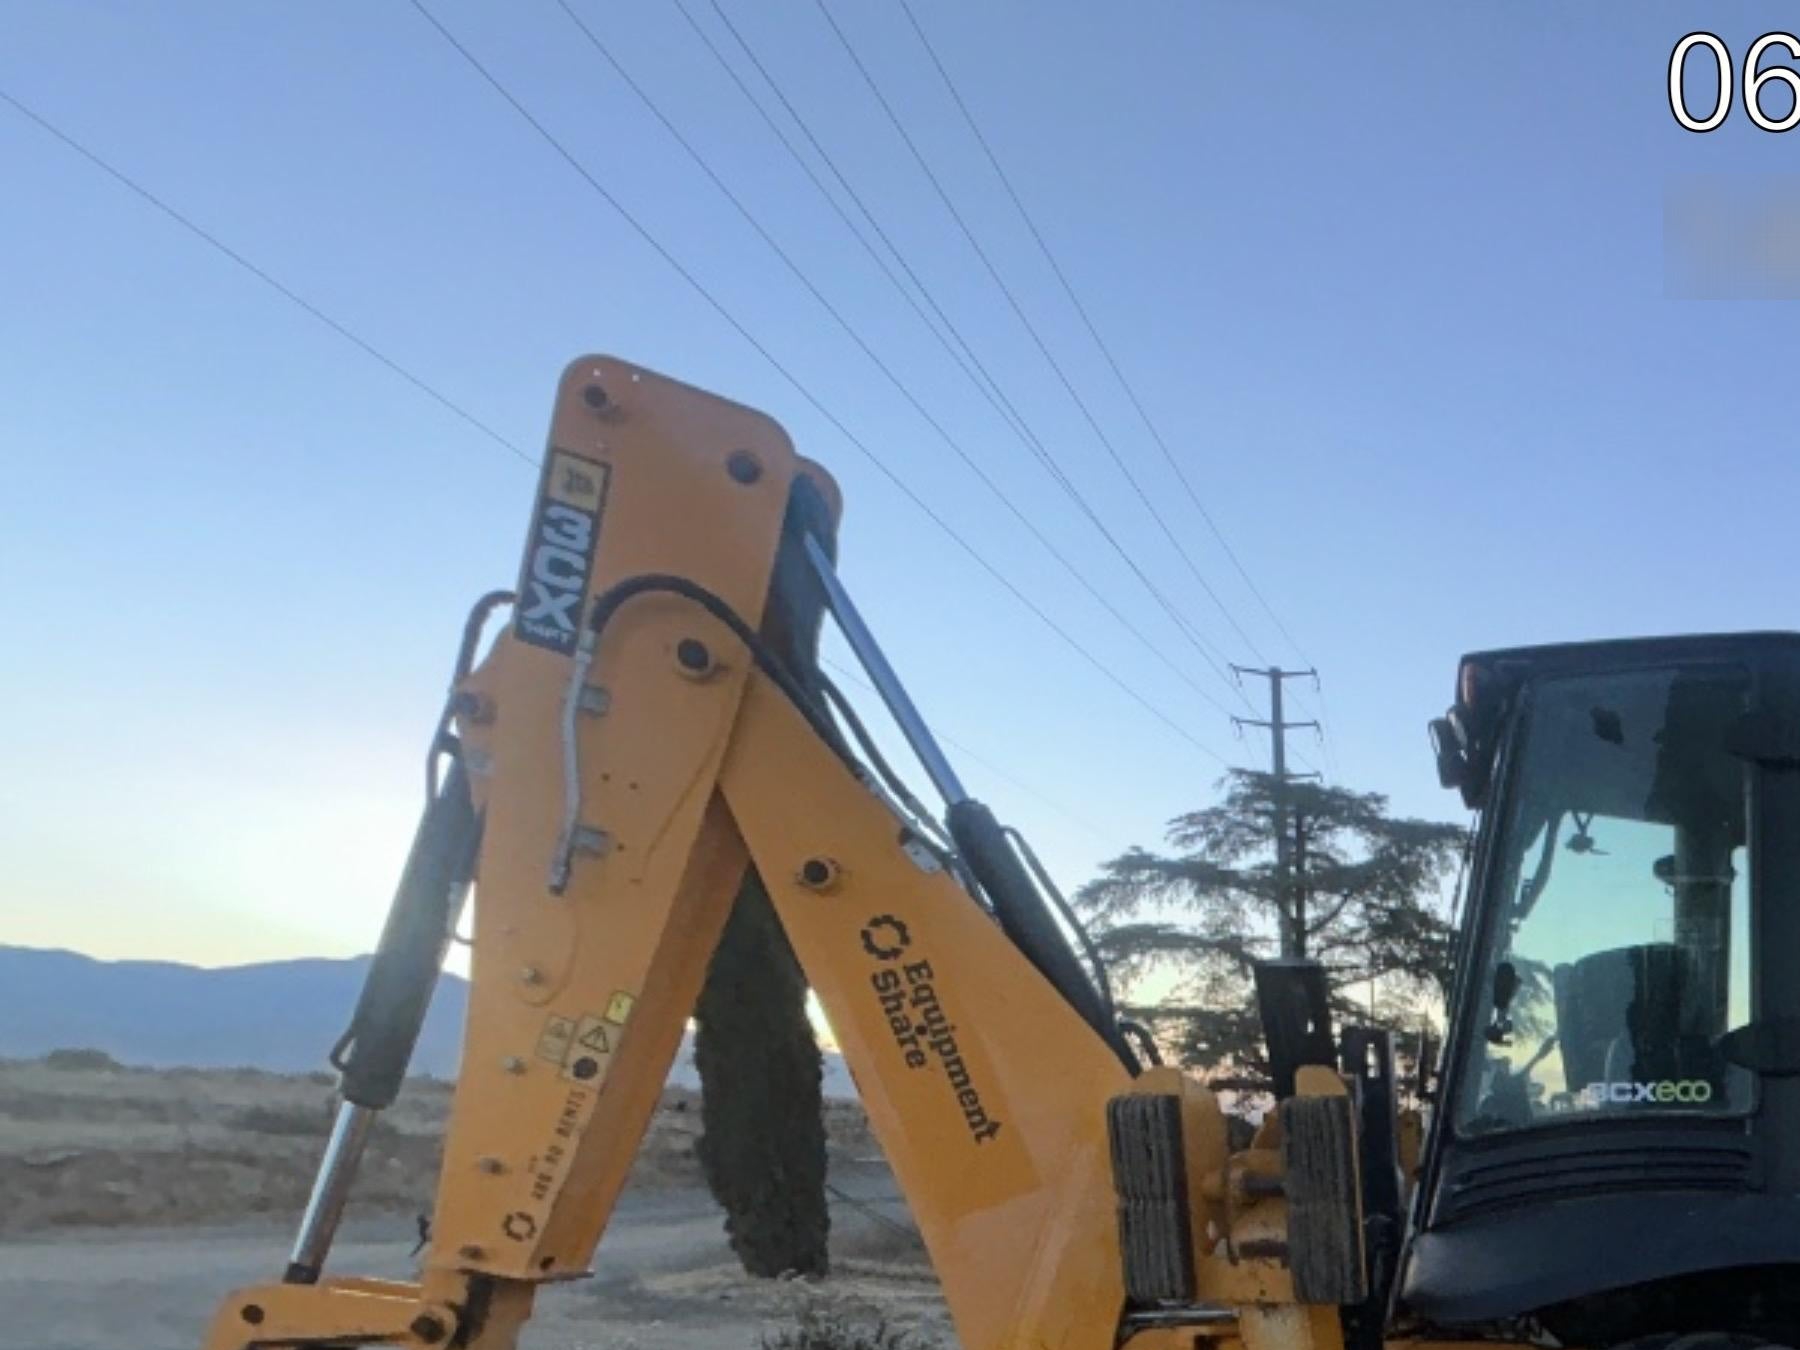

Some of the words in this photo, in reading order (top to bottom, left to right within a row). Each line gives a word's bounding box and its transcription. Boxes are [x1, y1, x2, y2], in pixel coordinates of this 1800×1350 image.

[523, 504, 593, 633] 3CX
[870, 968, 927, 1070] Share
[903, 959, 1002, 1146] Equipment
